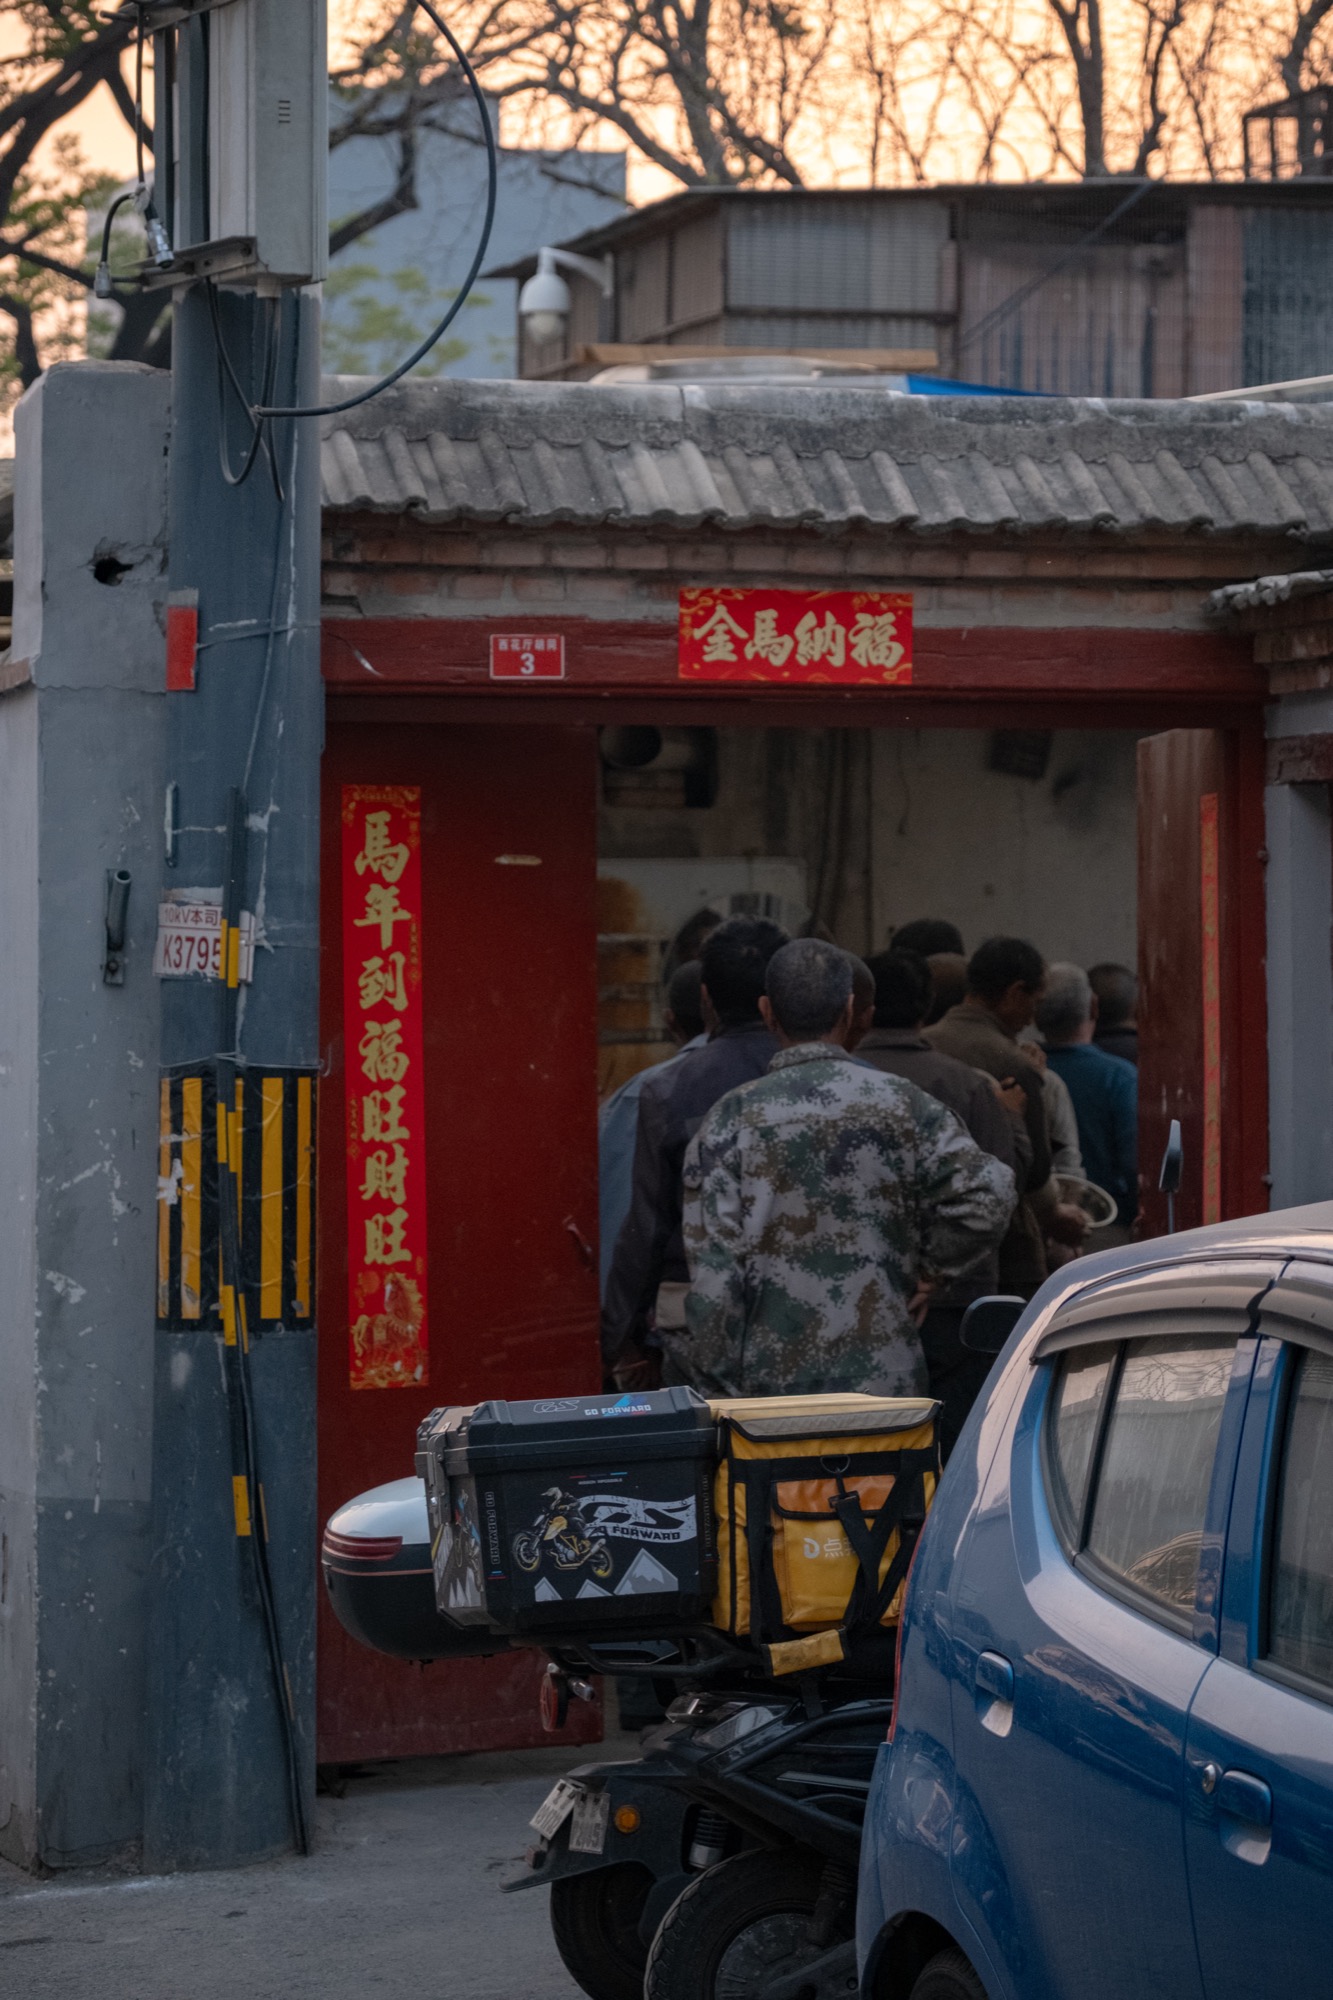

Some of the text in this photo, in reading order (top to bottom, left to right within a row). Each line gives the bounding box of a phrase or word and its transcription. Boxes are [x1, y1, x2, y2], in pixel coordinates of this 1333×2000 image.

[693, 604, 905, 668] 金馬納福
[520, 652, 535, 675] 3
[353, 810, 412, 1266] 馬年到福旺財旺
[584, 1404, 652, 1416] GO FORWARD
[612, 1525, 681, 1540] FORWARD
